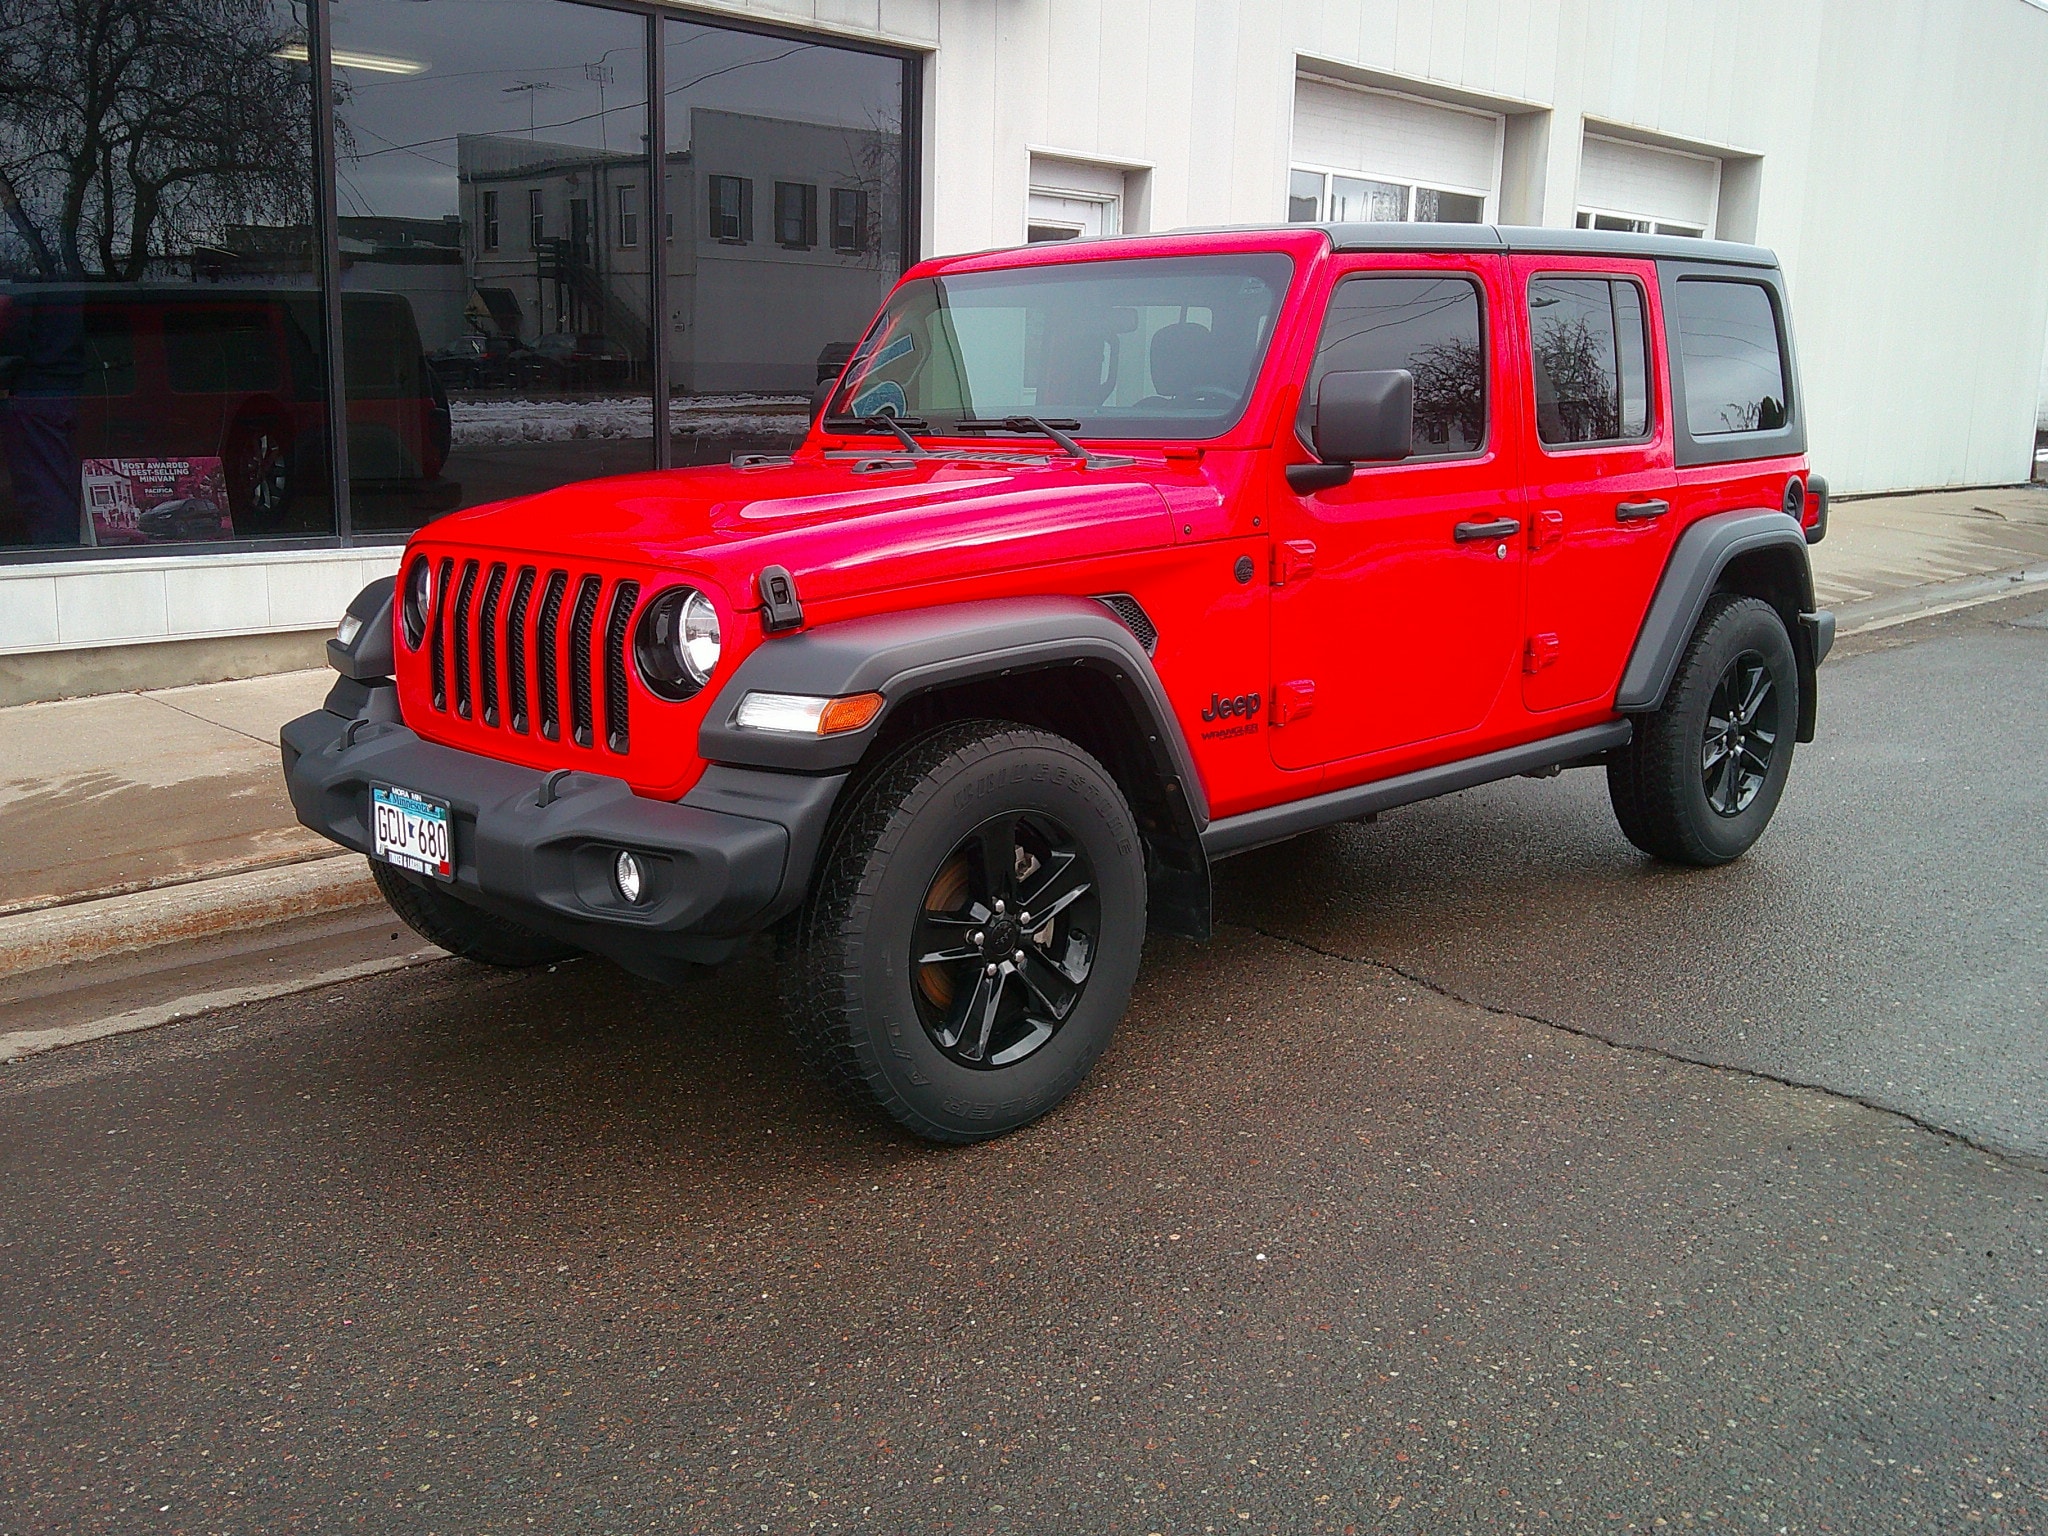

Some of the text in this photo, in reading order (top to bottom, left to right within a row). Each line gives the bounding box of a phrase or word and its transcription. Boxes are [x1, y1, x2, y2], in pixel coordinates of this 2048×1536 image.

[131, 468, 190, 476] BEST-SELLING
[139, 475, 175, 483] MINIVAN
[1201, 692, 1261, 722] Jeep
[378, 805, 447, 860] GCU 680
